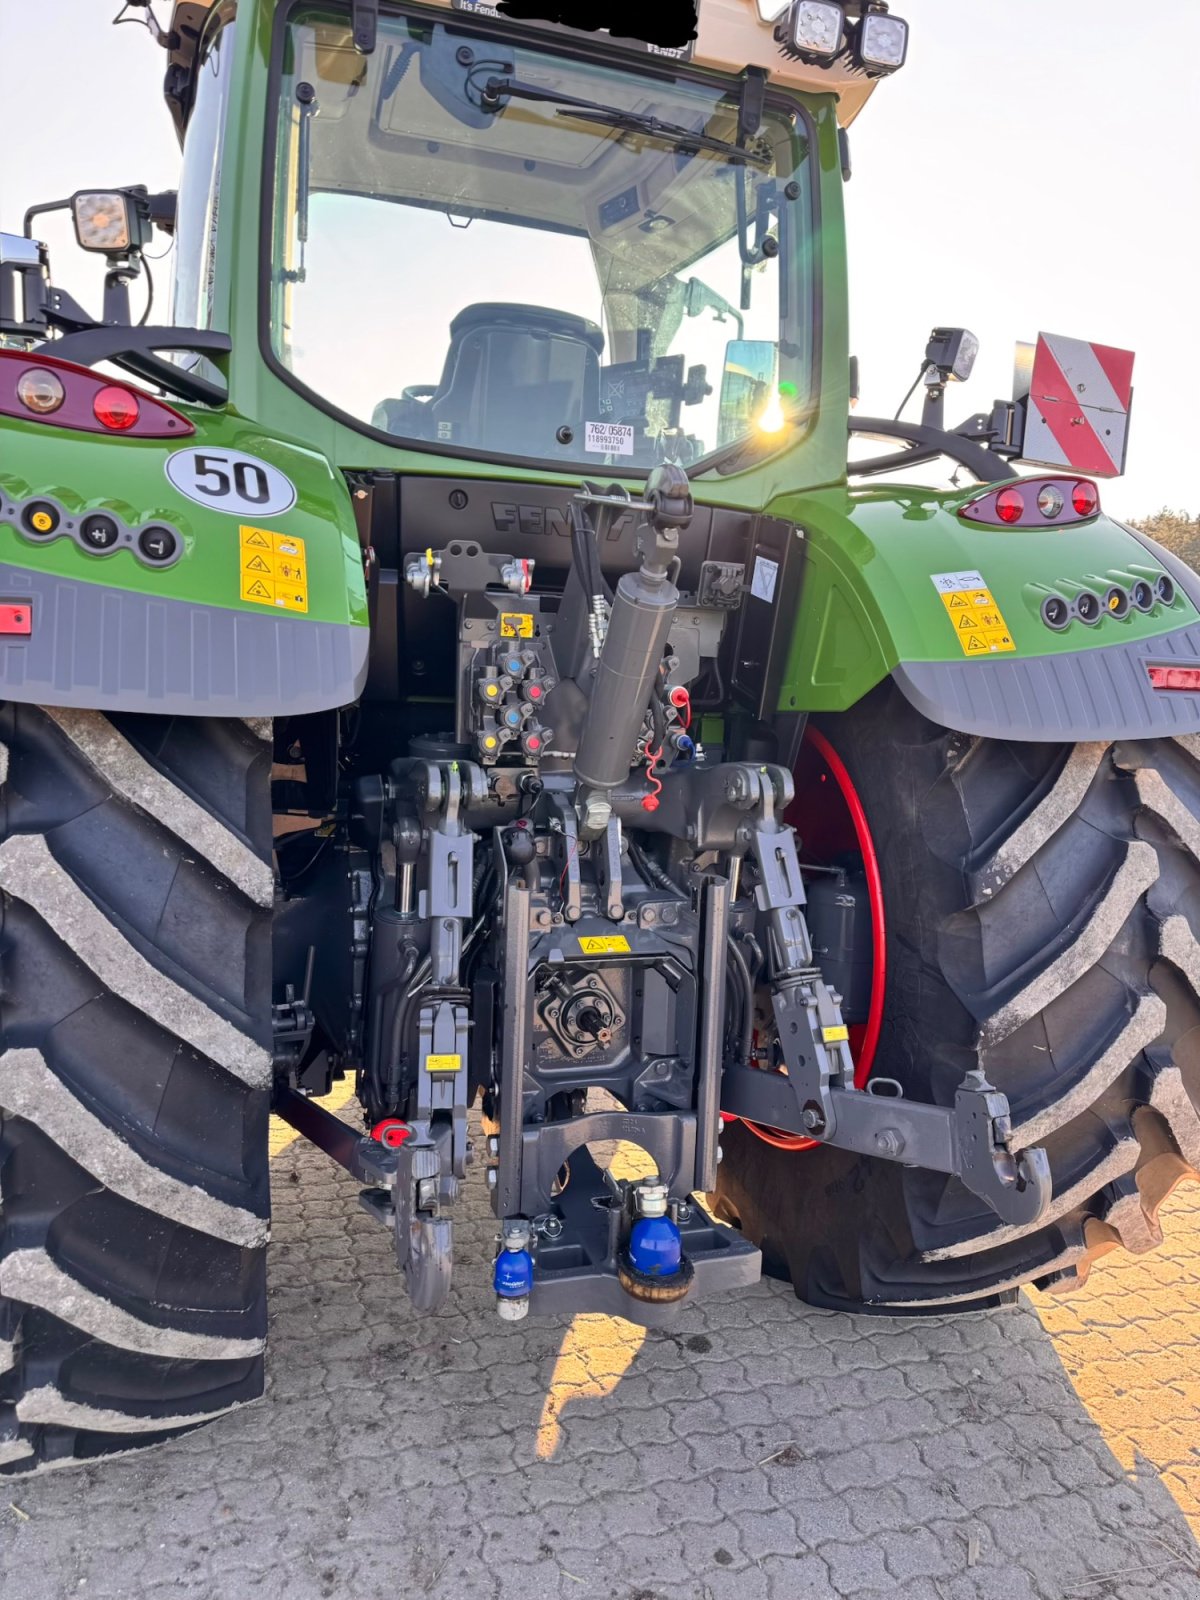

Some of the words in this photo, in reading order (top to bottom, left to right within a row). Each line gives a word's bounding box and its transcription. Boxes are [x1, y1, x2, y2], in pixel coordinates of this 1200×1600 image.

[460, 0, 473, 11] It's
[194, 454, 270, 504] 50
[490, 501, 633, 542] FENT
